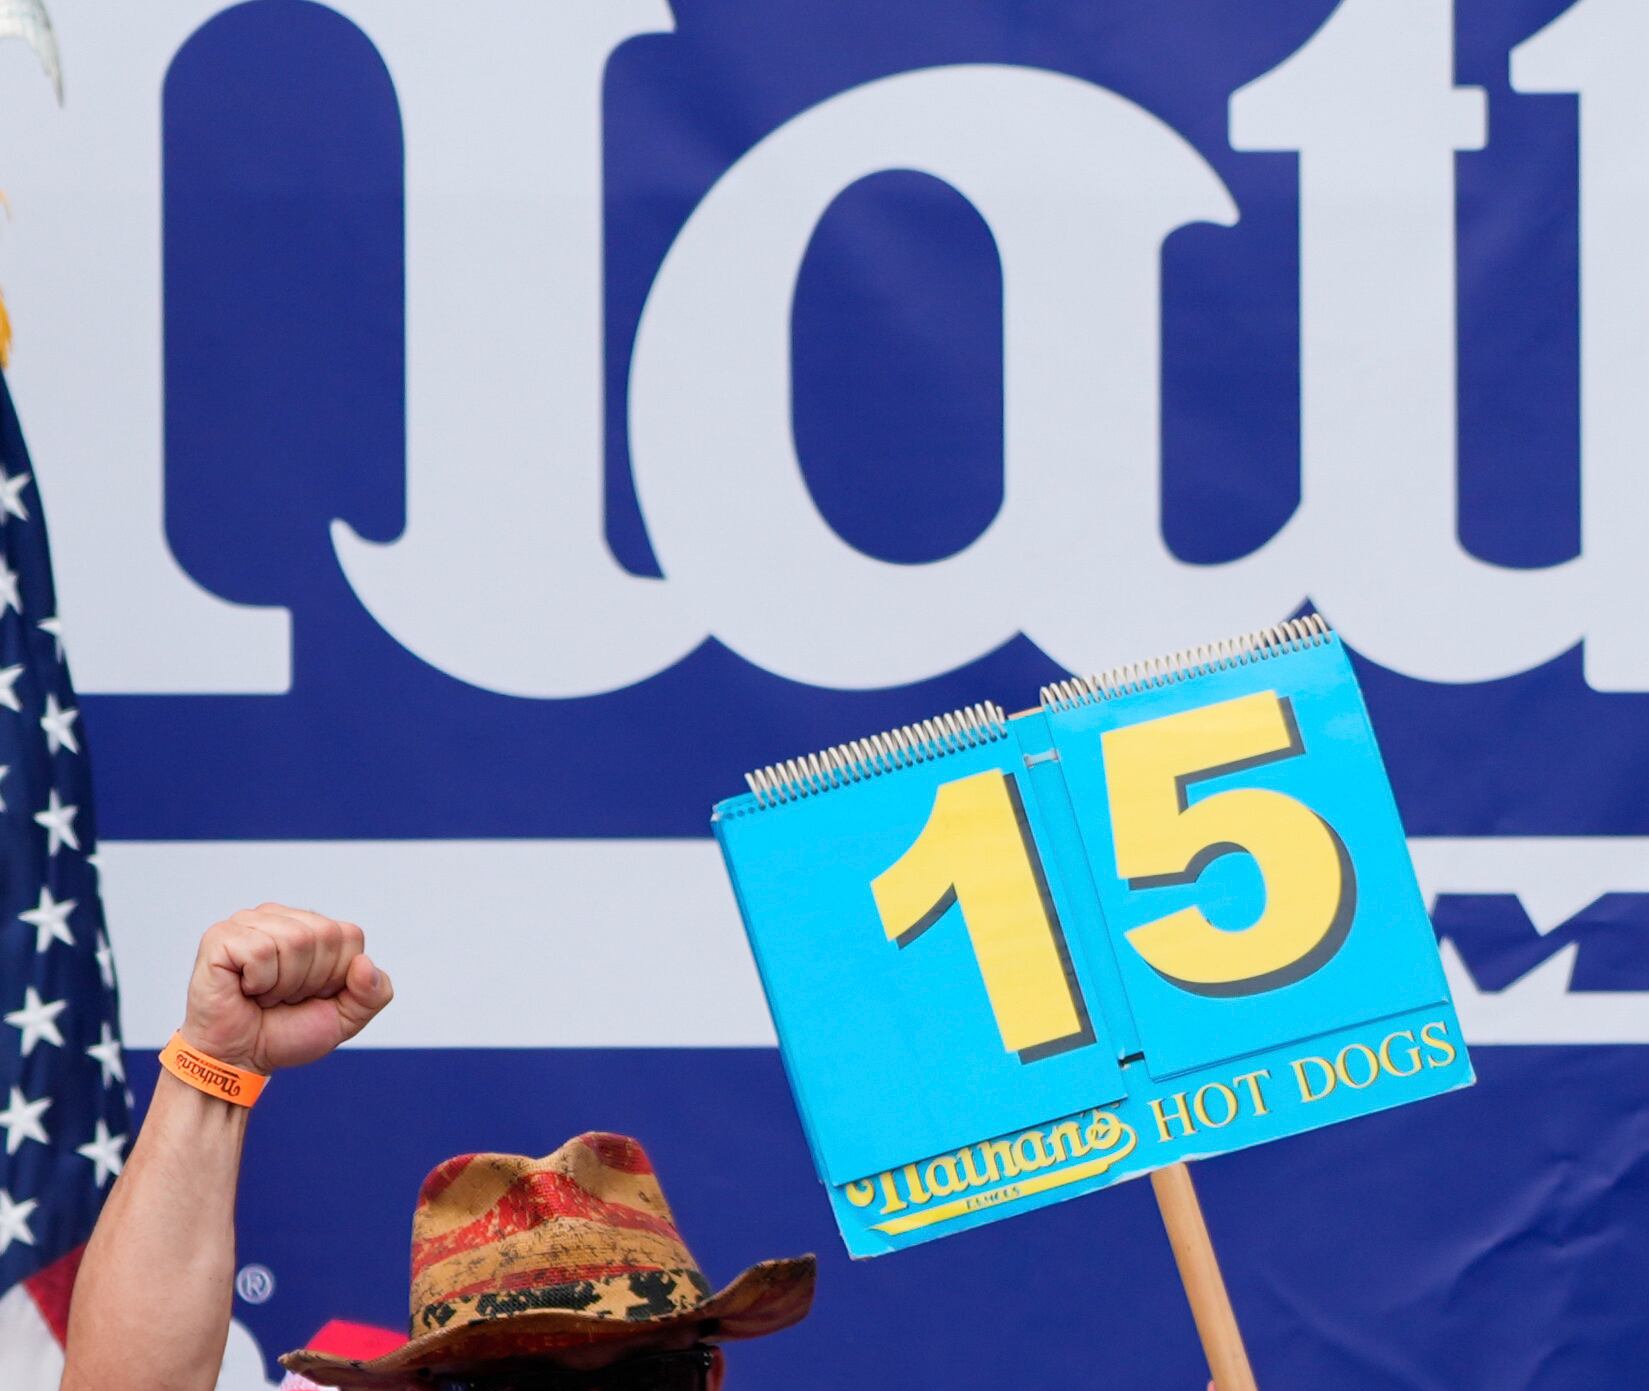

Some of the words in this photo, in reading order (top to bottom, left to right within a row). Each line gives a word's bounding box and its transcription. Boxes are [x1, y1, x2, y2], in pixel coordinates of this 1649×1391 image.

[870, 690, 1352, 1062] 15
[845, 1106, 1123, 1214] Nathans
[1147, 1069, 1271, 1143] HOT
[1289, 1021, 1456, 1104] DOGS
